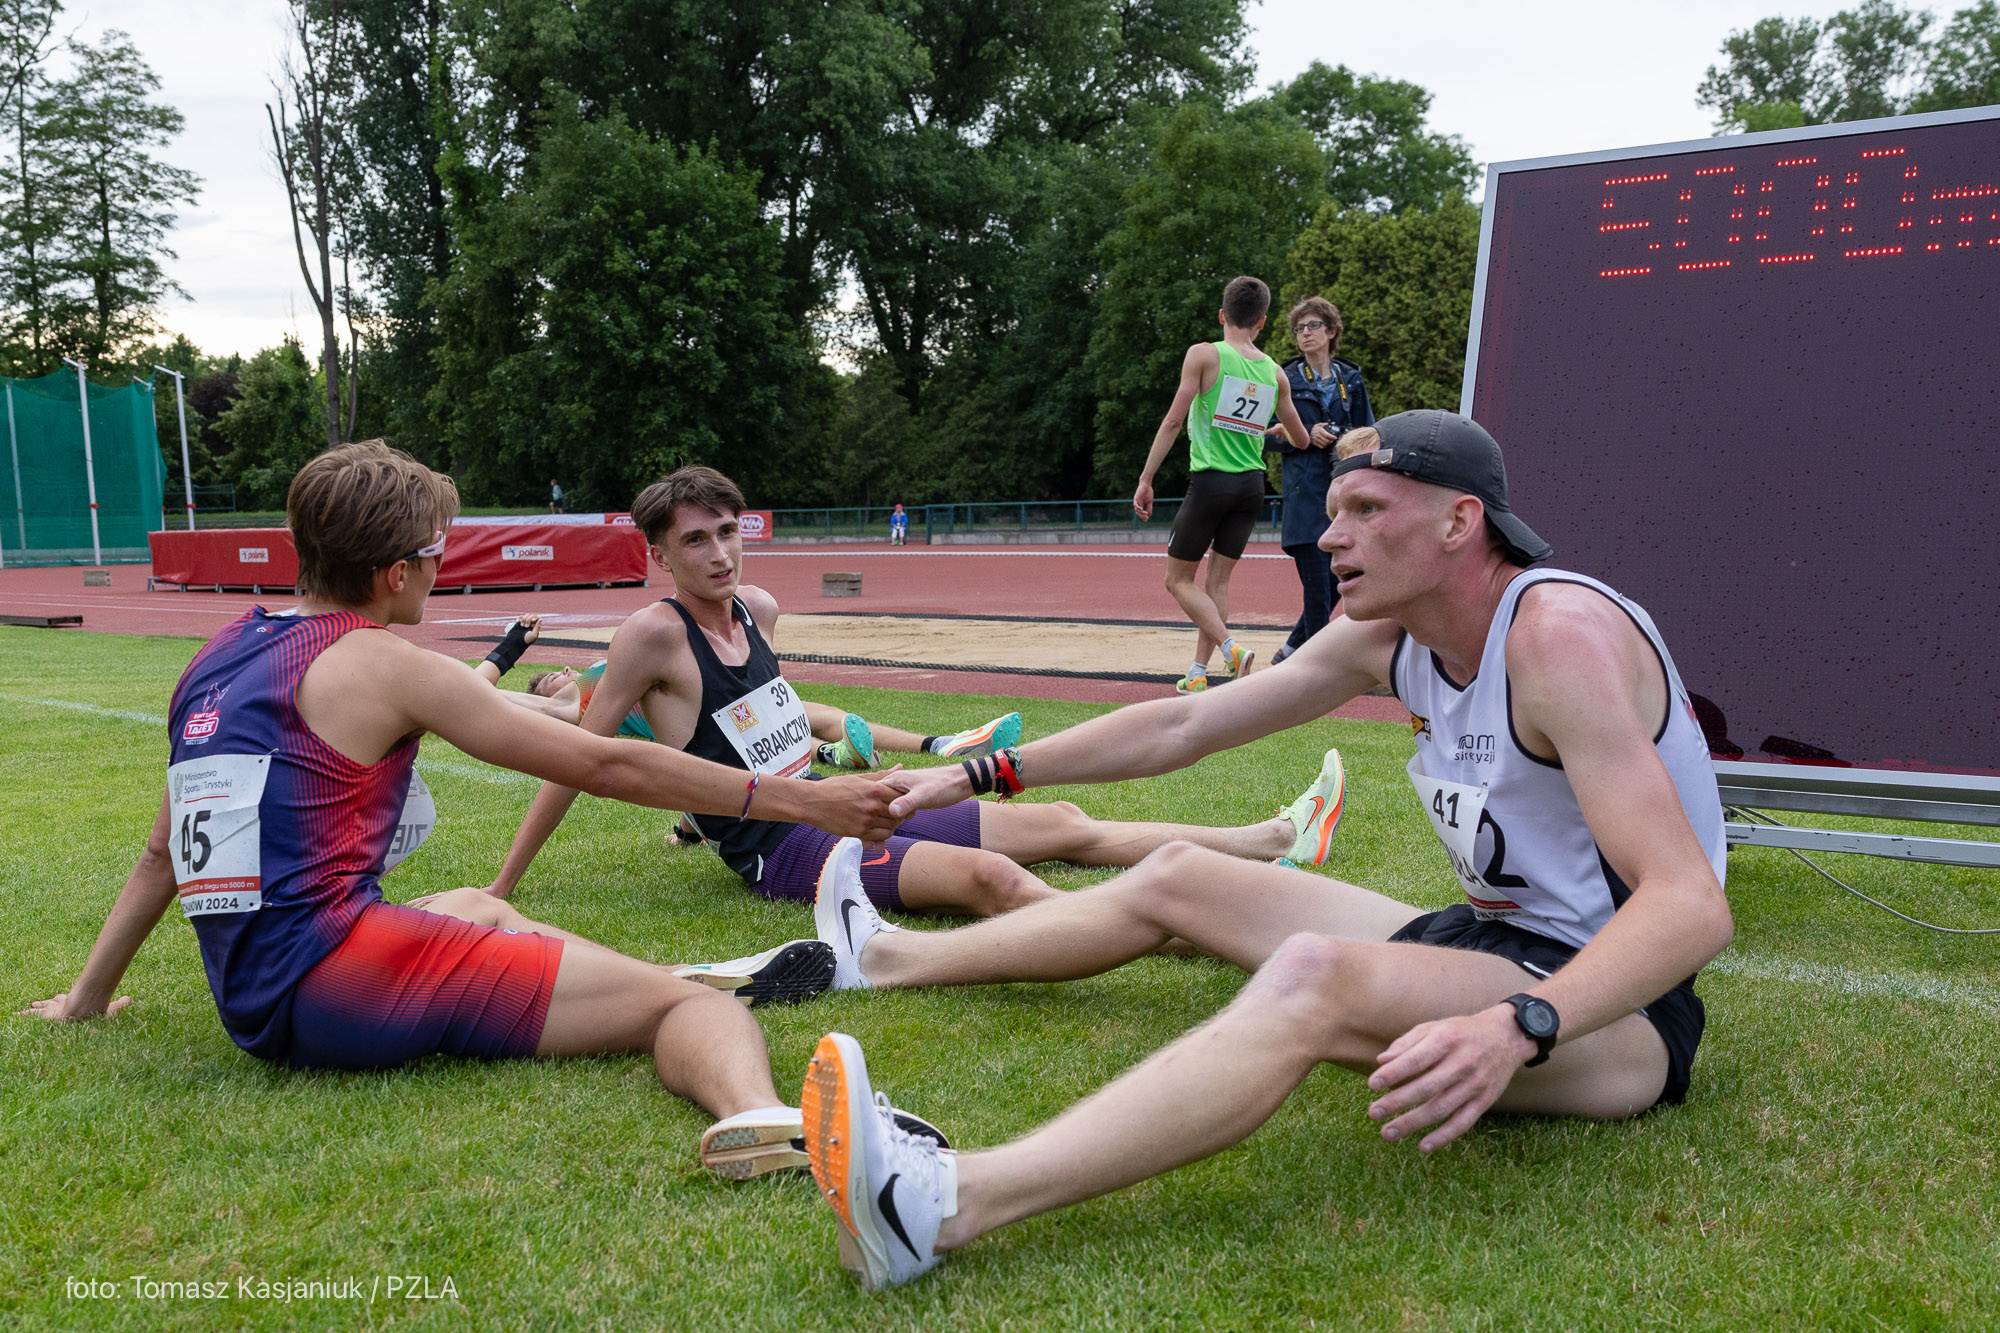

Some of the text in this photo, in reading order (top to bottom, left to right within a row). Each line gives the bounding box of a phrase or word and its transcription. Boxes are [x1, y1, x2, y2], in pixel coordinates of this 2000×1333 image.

[1232, 397, 1259, 420] 27
[518, 547, 550, 558] polanik
[771, 682, 790, 708] 39
[737, 717, 758, 732] PZLA
[745, 713, 811, 769] ABRAMCZYK
[184, 769, 217, 782] Ministerstwo
[1432, 788, 1460, 829] 41
[181, 809, 212, 875] 45
[206, 897, 239, 910] 2024
